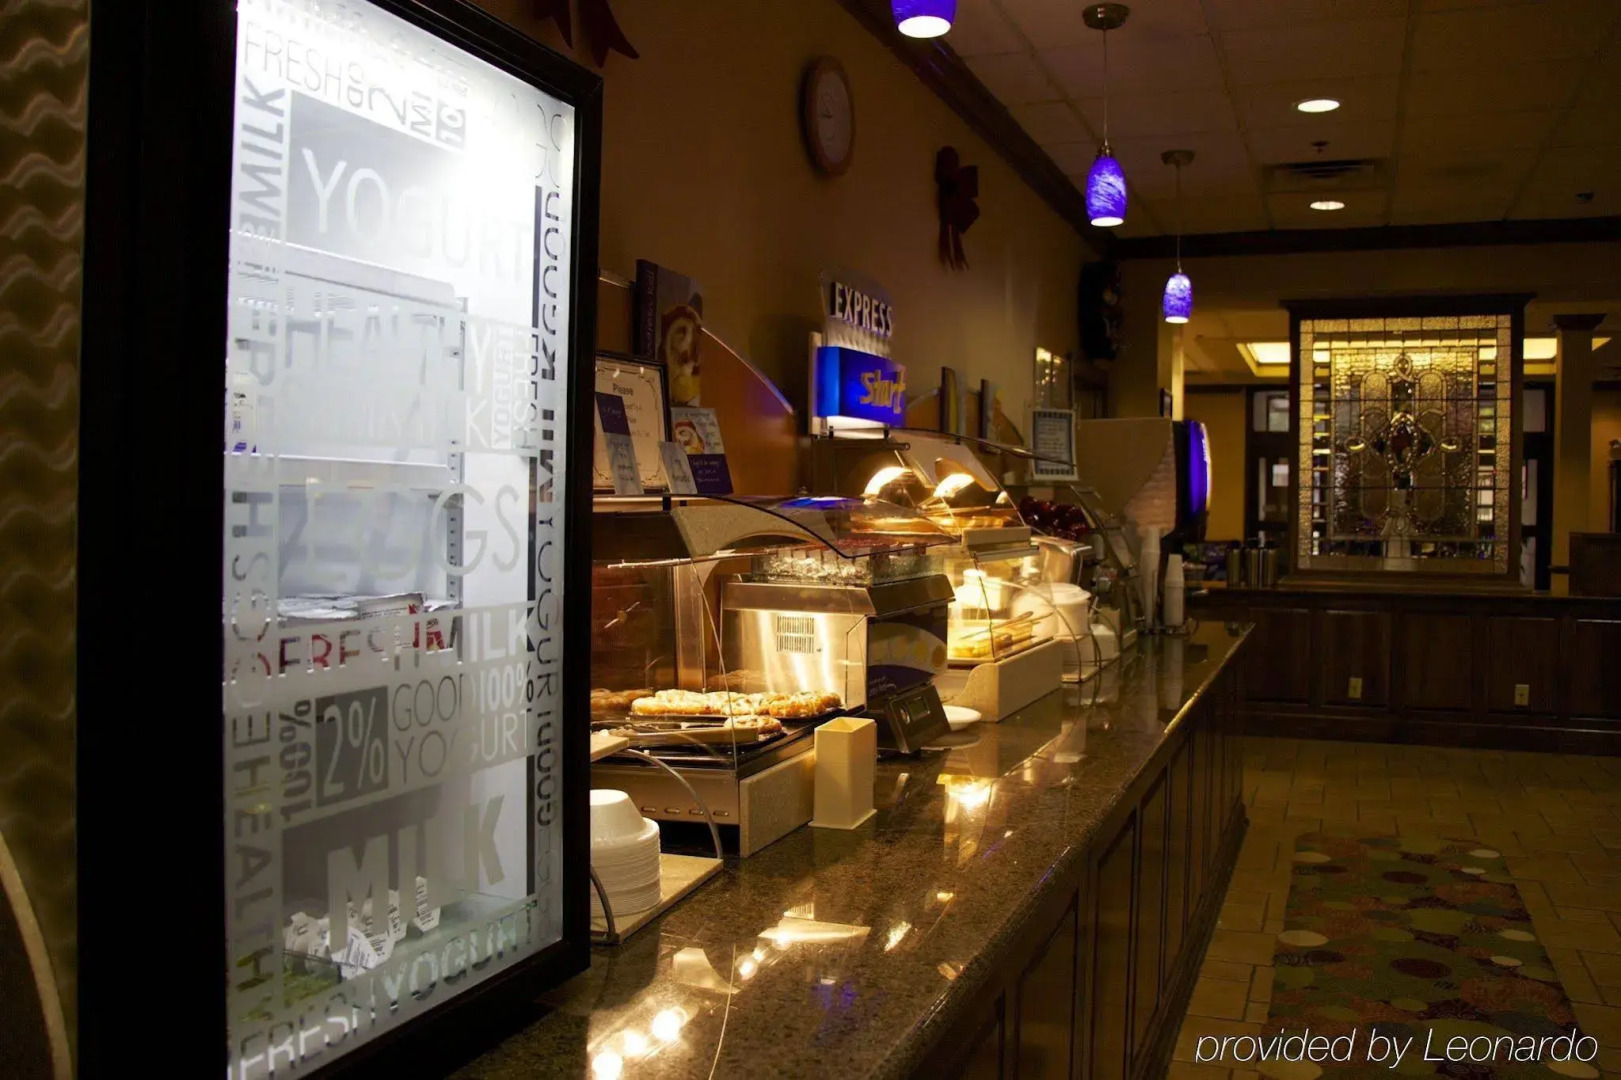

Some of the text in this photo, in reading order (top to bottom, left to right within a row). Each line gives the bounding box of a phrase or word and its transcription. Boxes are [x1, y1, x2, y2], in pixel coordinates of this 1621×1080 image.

[244, 20, 343, 103] FRESH
[239, 74, 286, 217] MILK
[833, 281, 894, 338] EXPRESS
[612, 382, 634, 397] Please
[860, 364, 907, 414] Start
[322, 696, 386, 798] 2%
